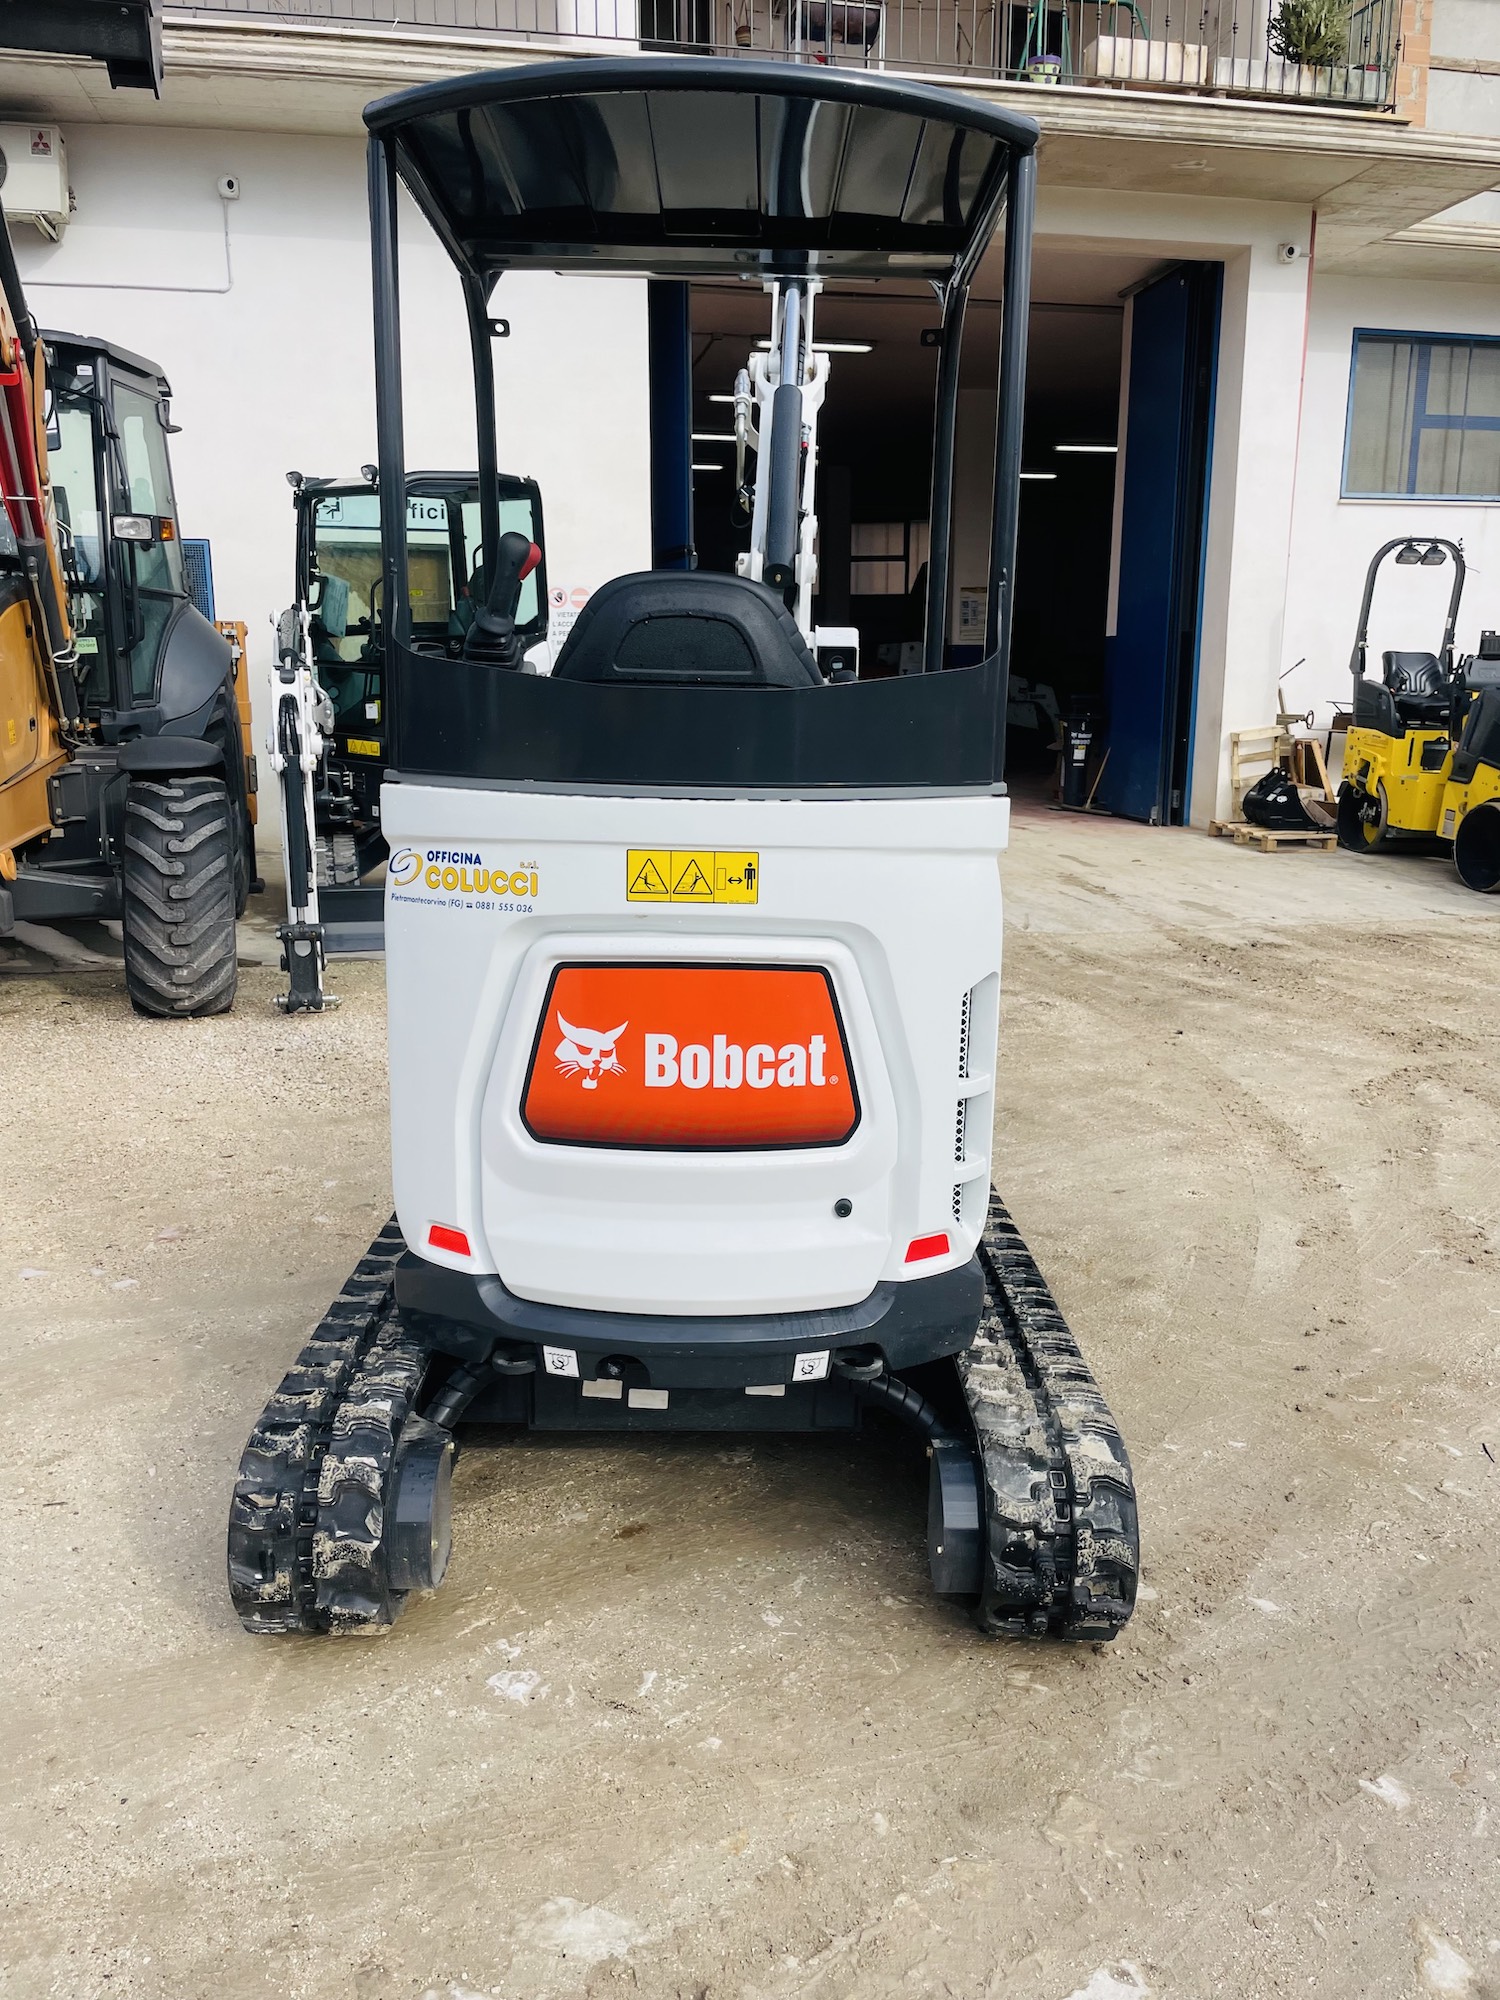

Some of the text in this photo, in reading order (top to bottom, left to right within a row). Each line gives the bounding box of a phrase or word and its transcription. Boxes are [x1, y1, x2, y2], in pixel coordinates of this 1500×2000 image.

[427, 850, 482, 866] OFFICINA
[425, 865, 539, 897] COLUCCI
[390, 892, 533, 913] Pietramontecorvino (FG) 0881 555 036
[645, 1033, 826, 1090] Bobcat
